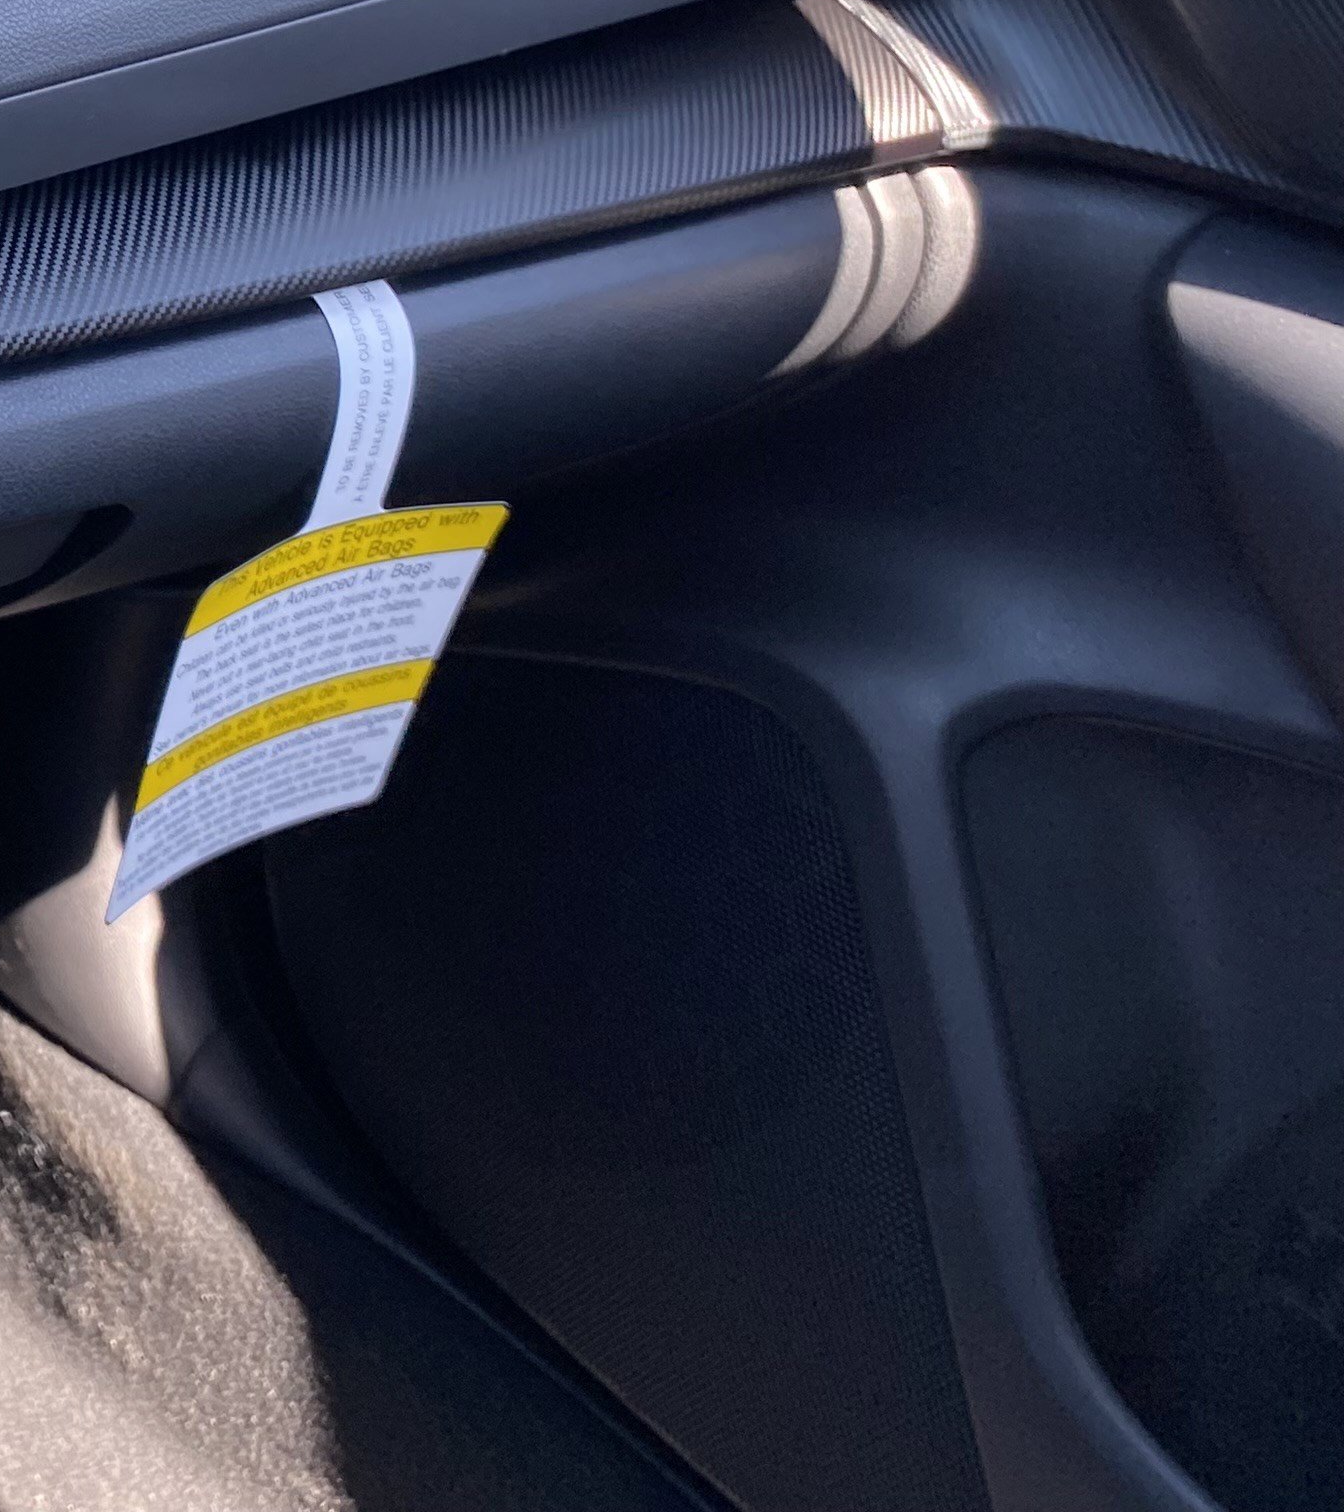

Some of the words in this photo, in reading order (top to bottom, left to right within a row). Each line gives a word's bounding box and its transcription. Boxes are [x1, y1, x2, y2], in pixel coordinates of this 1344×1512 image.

[246, 559, 326, 600] Advanced
[335, 546, 358, 566] Air
[367, 536, 417, 558] Bags
